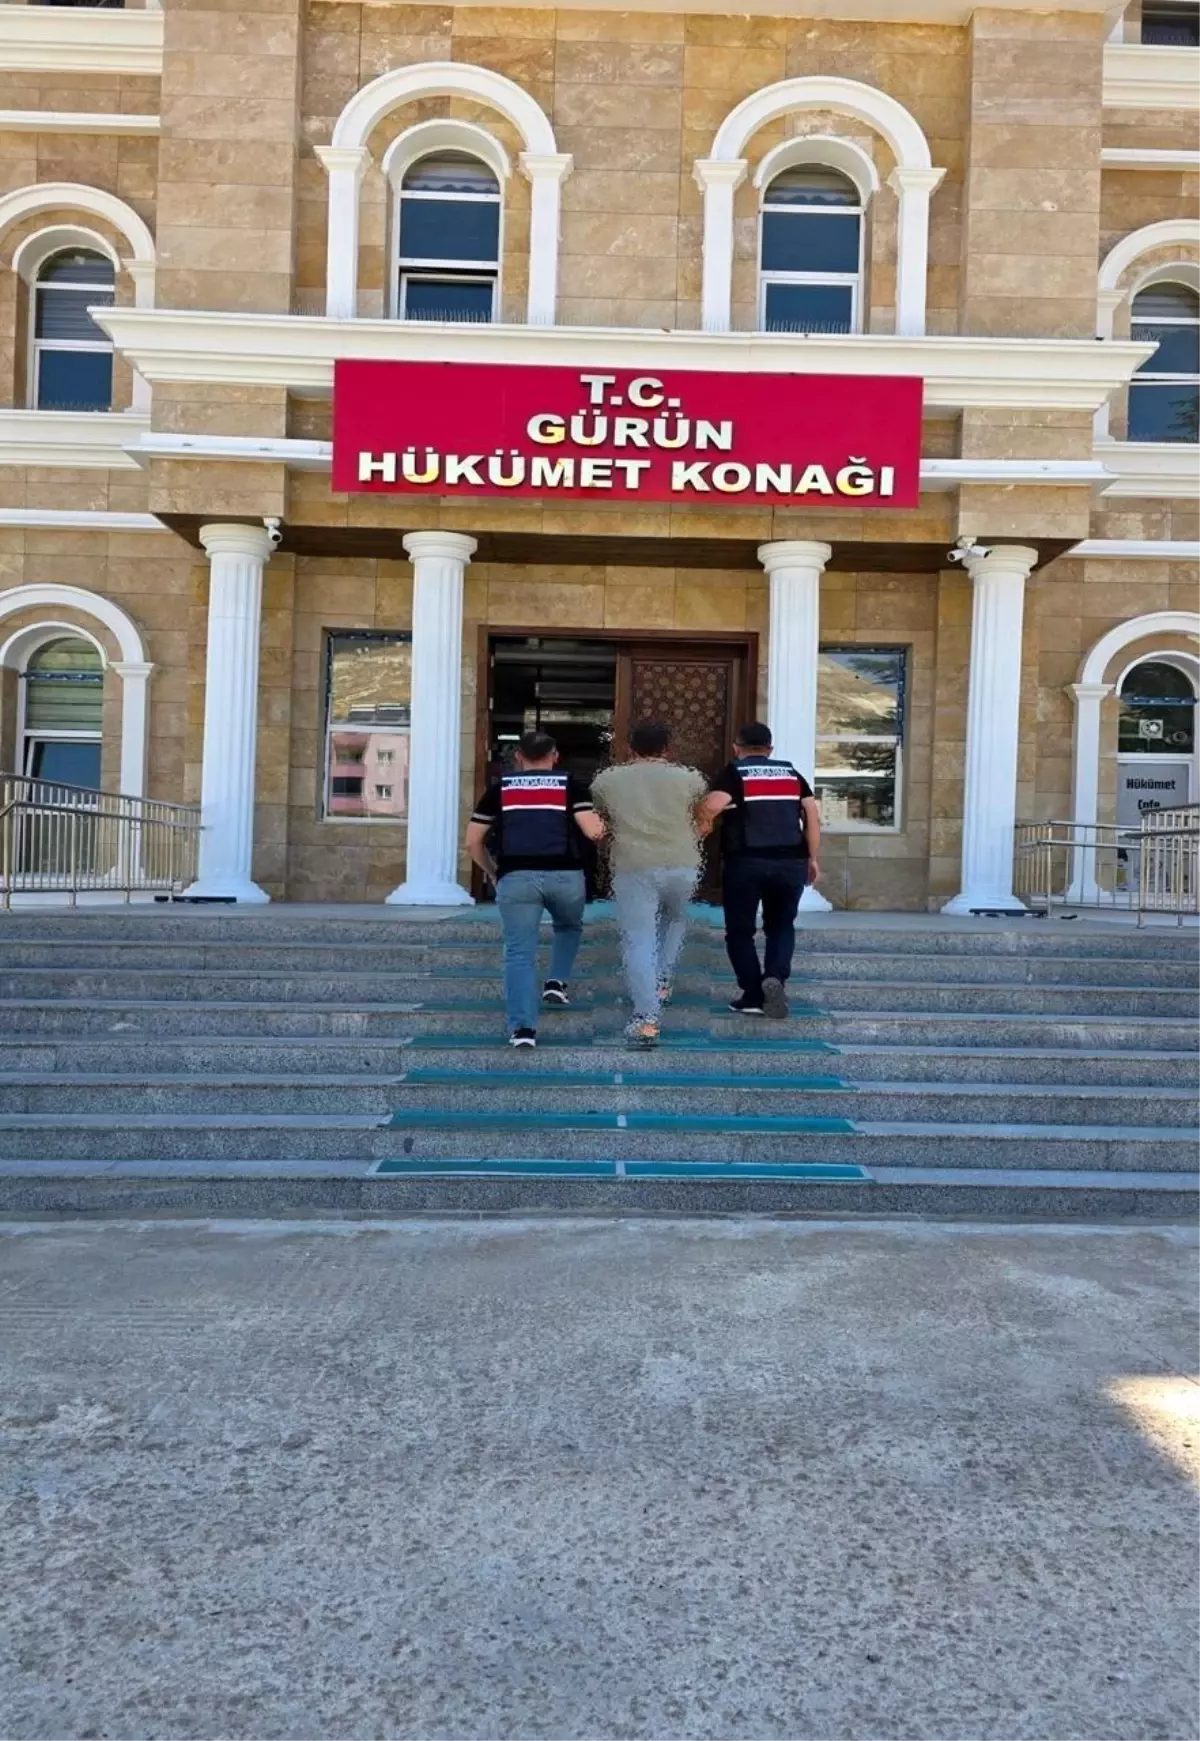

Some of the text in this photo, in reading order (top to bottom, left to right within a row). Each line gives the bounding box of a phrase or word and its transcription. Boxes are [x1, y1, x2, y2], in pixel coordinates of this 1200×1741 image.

[580, 374, 681, 408] T.C.
[526, 409, 733, 450] GÜRÜN
[358, 446, 895, 496] HÜKÜMET KONAĞI
[508, 778, 560, 788] JANDARMA
[1126, 778, 1176, 790] Hükümet
